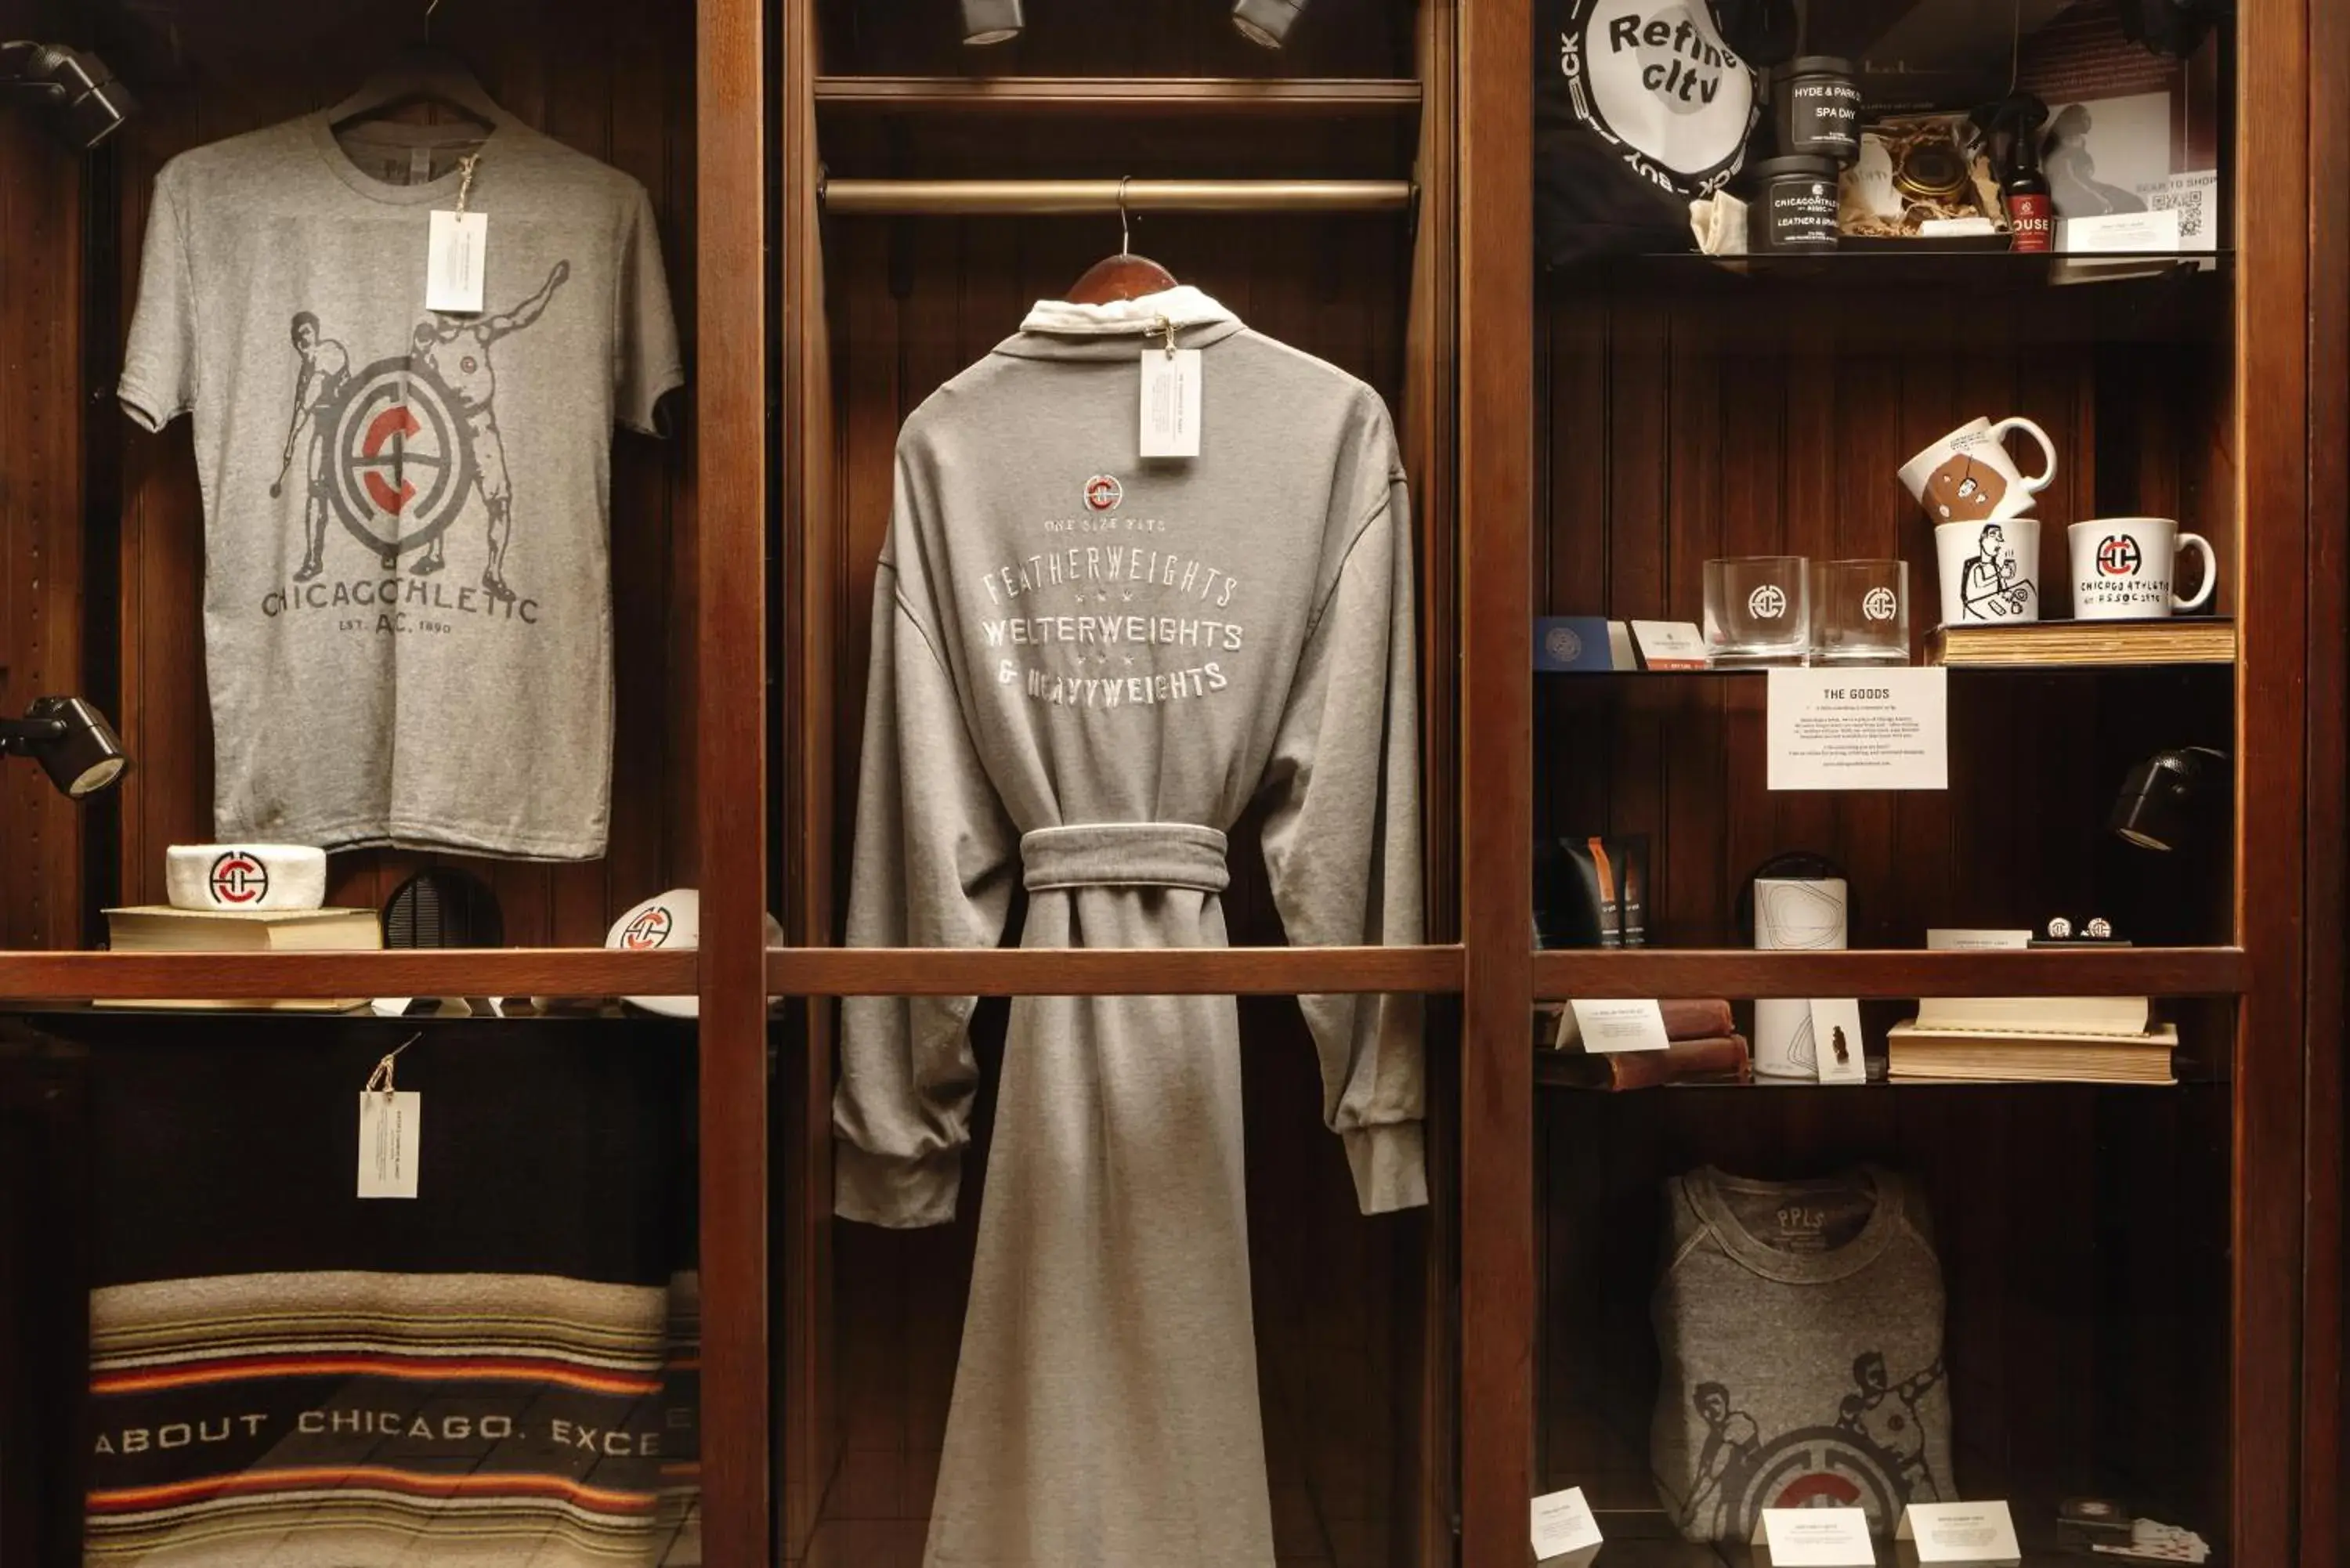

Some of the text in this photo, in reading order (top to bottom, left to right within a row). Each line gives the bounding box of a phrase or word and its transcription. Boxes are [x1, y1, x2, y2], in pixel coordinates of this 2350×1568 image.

[1795, 87, 1823, 98] HYDE
[1824, 87, 1832, 96] &
[1816, 107, 1837, 117] SPA
[1623, 151, 1675, 193] BUY
[1044, 519, 1076, 533] ONE
[1081, 517, 1118, 533] SIZE
[981, 546, 1238, 608] FEATHERWEIGHTS
[2081, 581, 2124, 591] CHICAGO
[262, 579, 400, 618] CHICAGO
[982, 615, 1244, 651] WELTERWEIGHTS
[998, 659, 1228, 708] & HEAVYWEIGHTS
[1824, 688, 1890, 699] THE GOODS
[94, 1410, 661, 1457] ABOUT CHICAGO. EXCE
